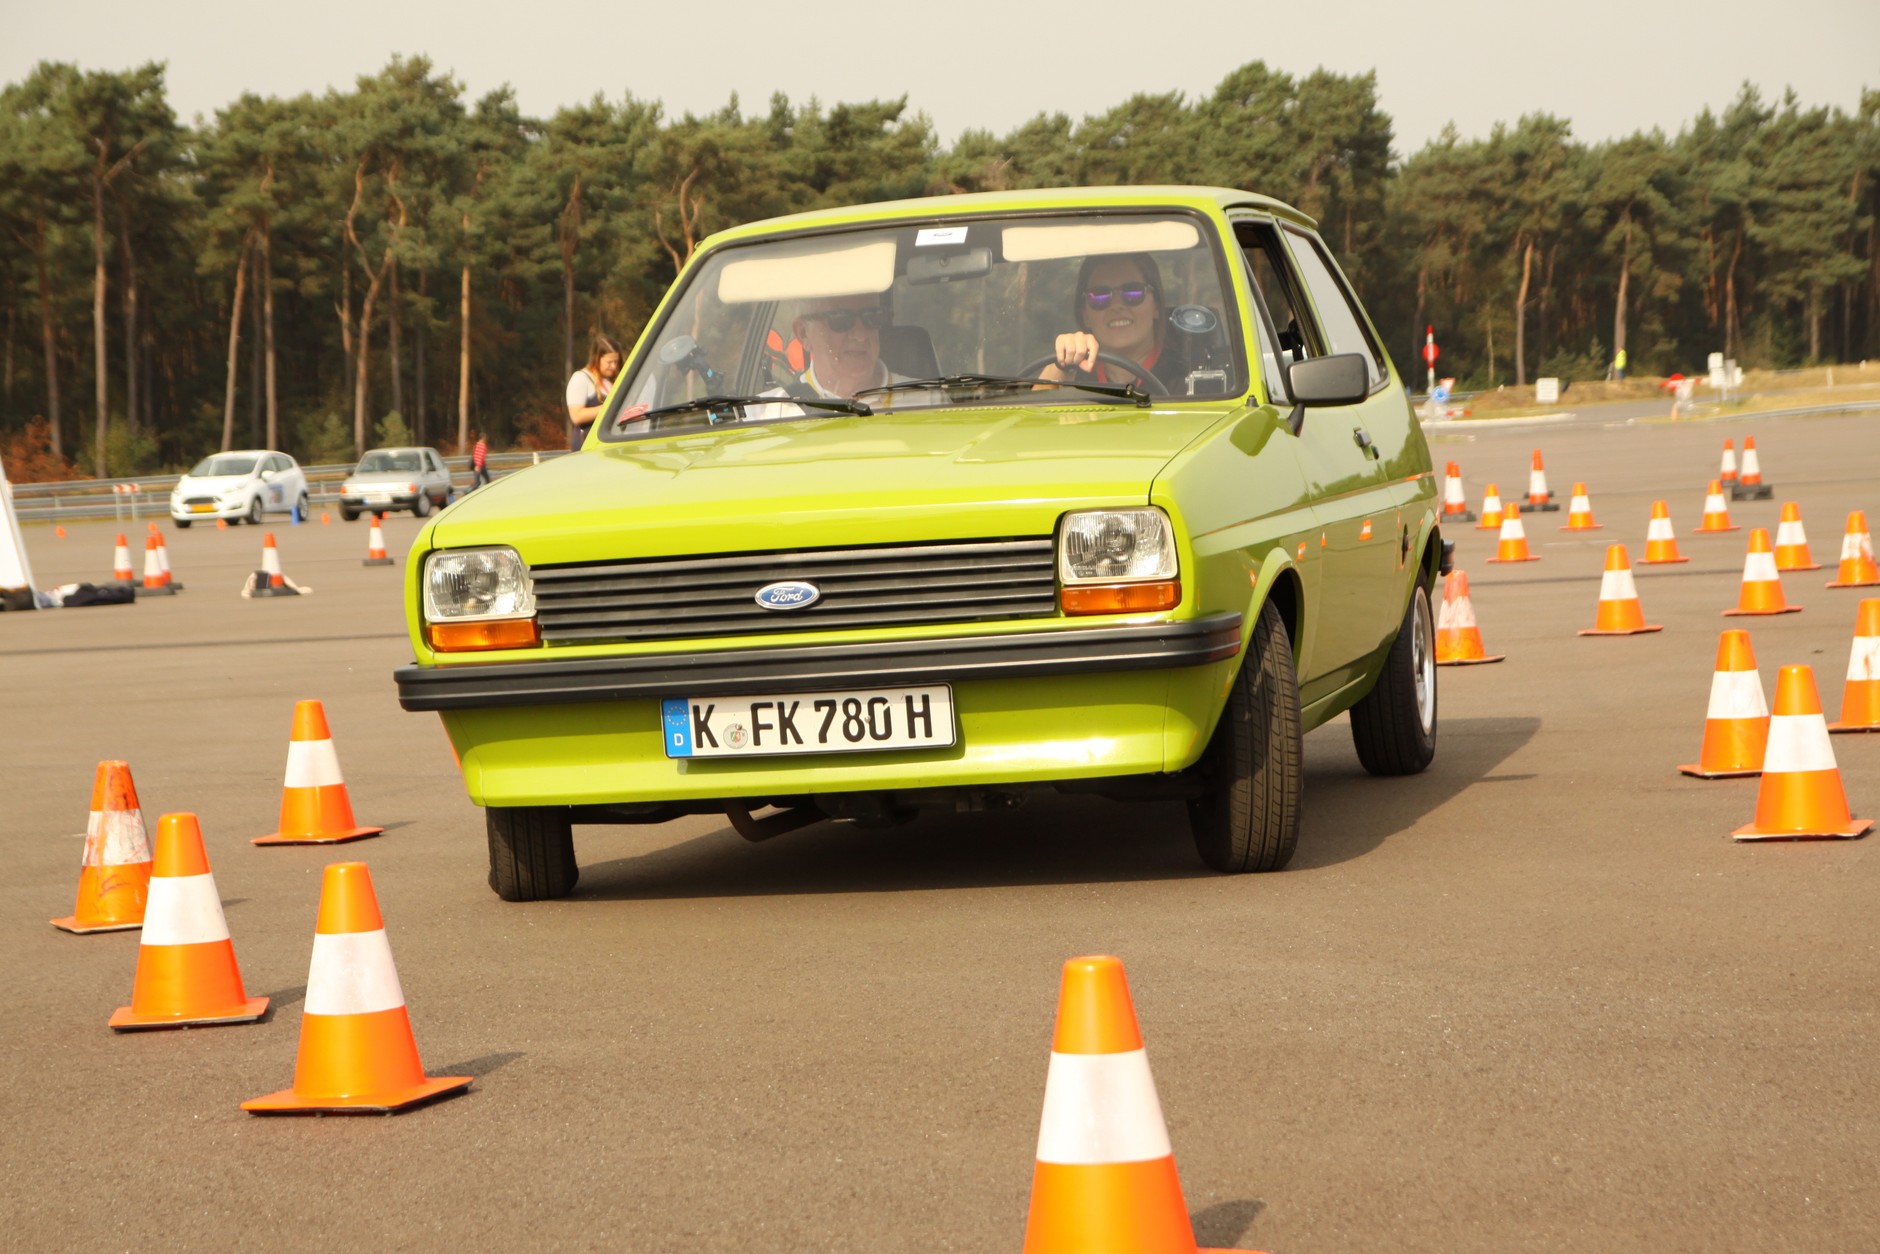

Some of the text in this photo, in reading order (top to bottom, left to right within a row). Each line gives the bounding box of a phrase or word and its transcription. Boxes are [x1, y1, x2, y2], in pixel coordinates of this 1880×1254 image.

[770, 586, 803, 603] Ford
[693, 694, 933, 748] K FK 780 H
[674, 734, 684, 747] D
